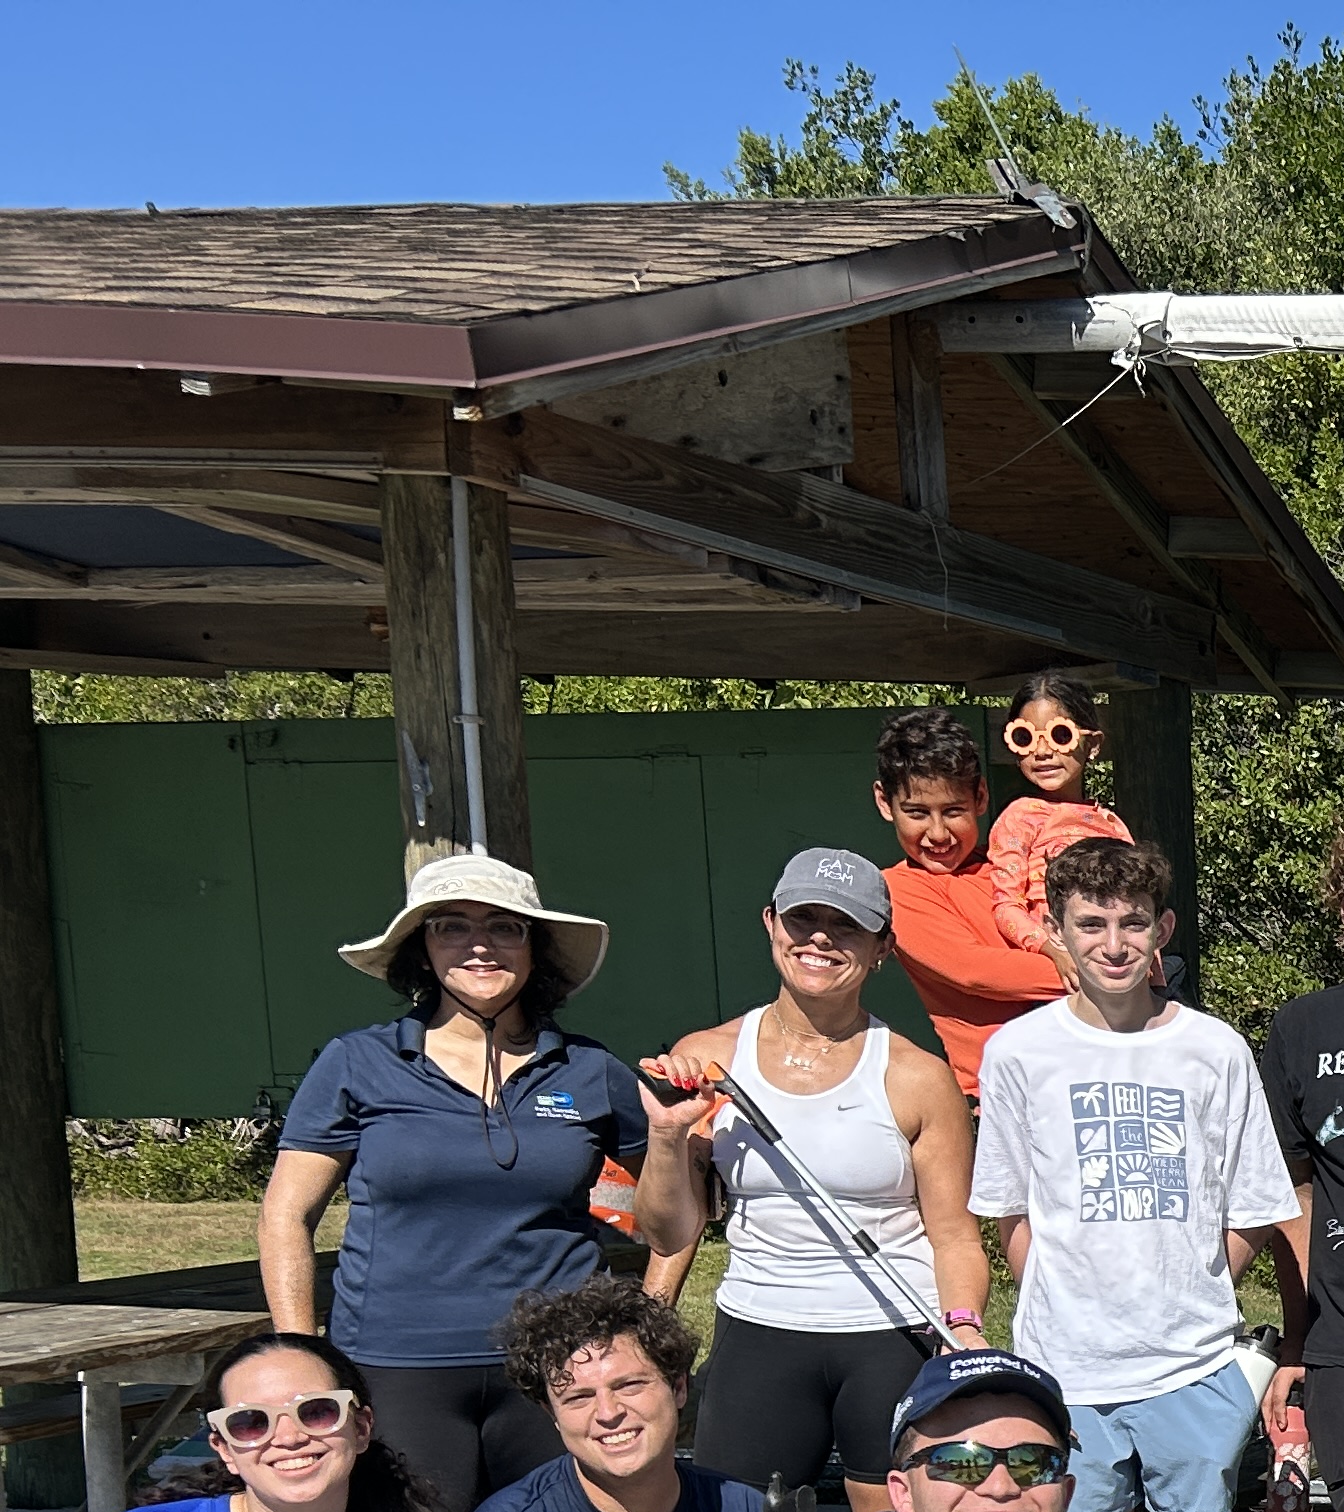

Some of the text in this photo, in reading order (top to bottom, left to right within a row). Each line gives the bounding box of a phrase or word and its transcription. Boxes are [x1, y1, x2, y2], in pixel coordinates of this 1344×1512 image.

[819, 858, 856, 874] CAT
[814, 867, 854, 886] MOM
[1115, 1085, 1144, 1115] FEEL
[1119, 1128, 1144, 1147] the
[949, 1356, 1021, 1370] Powered
